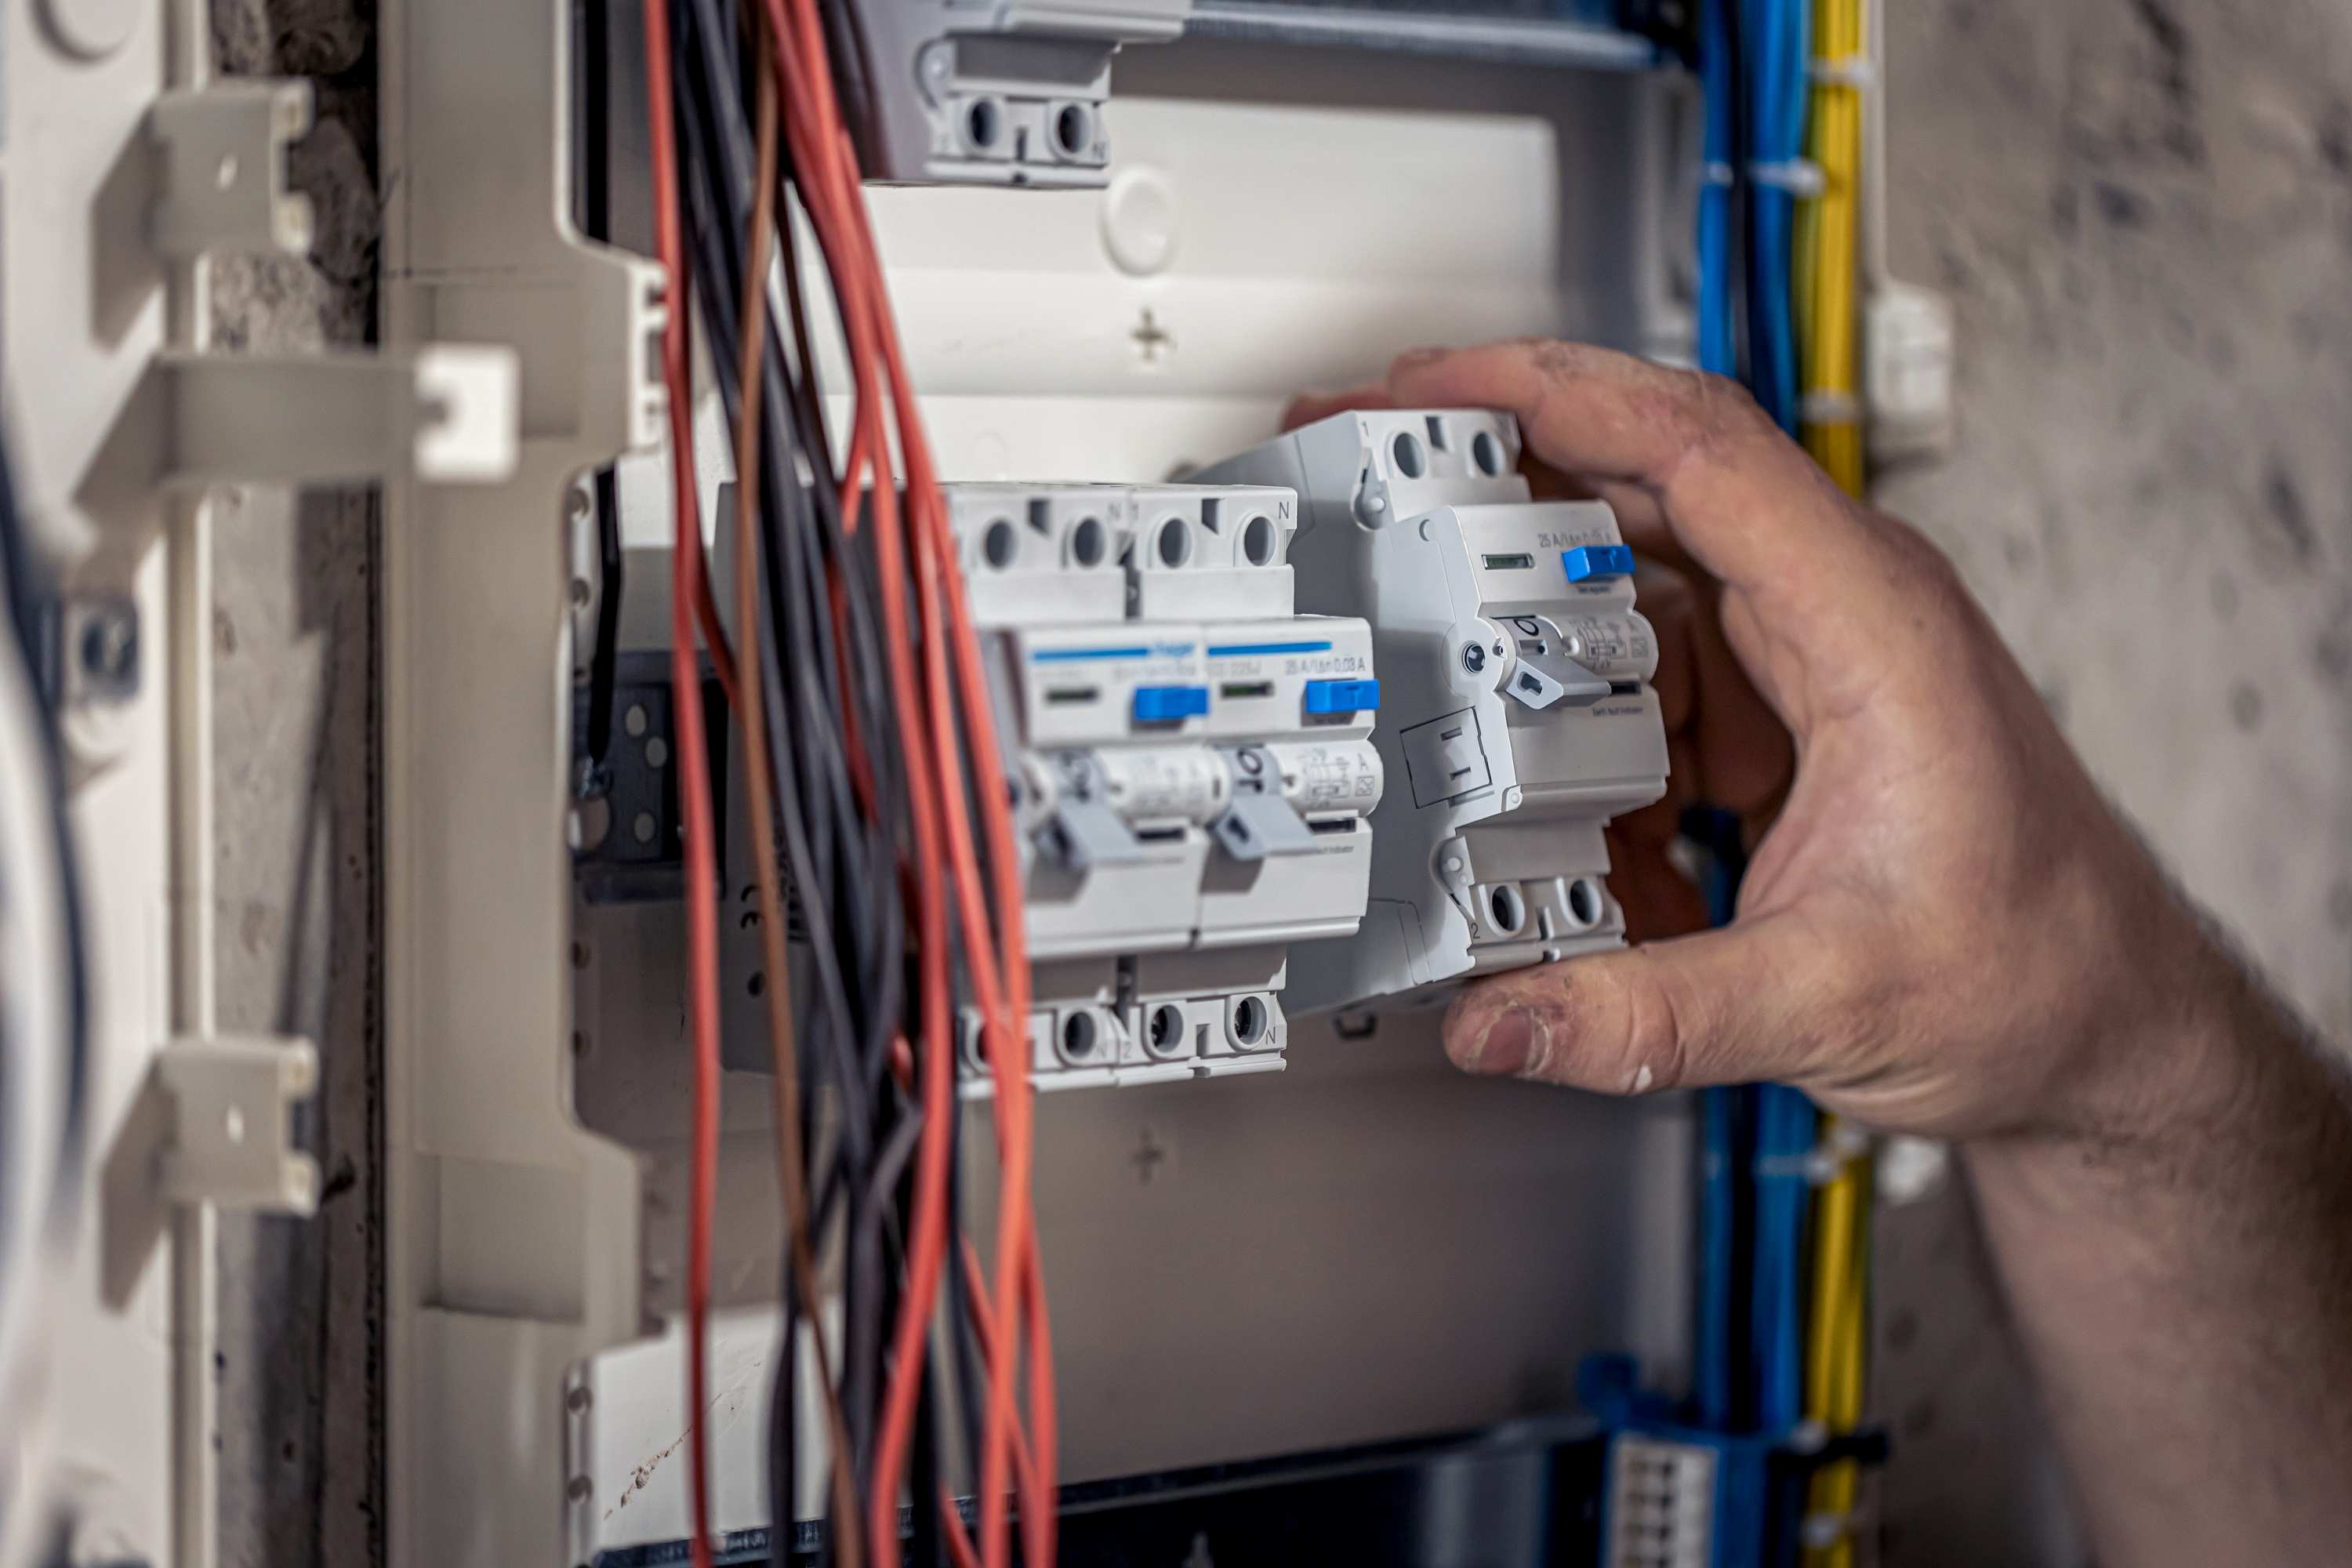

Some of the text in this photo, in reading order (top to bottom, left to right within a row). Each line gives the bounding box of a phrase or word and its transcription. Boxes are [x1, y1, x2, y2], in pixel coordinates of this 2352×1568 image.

[1279, 501, 1290, 519] N
[1537, 532, 1552, 548] 25
[1470, 922, 1481, 939] 2
[1265, 1025, 1276, 1045] N
[1123, 1041, 1131, 1058] 2
